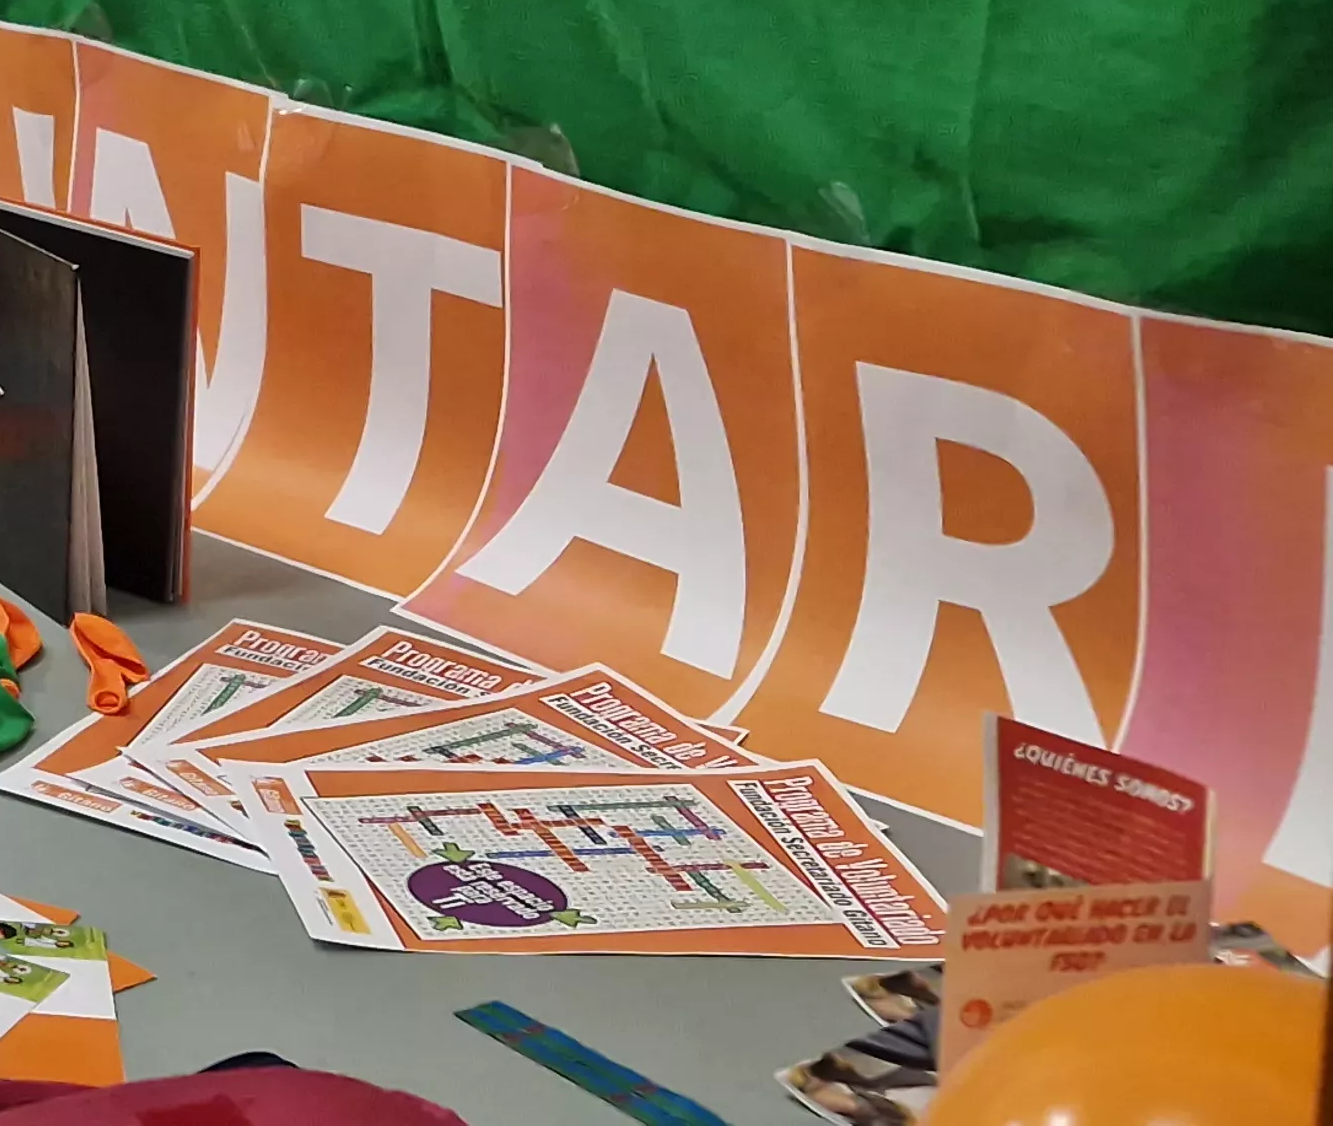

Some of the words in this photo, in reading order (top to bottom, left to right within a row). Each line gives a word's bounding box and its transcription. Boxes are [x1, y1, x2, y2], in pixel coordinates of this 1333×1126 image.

[368, 657, 470, 694] Fundación
[381, 640, 502, 689] Programa
[548, 695, 633, 745] Fundación
[570, 681, 677, 744] Programa
[663, 741, 707, 761] de
[763, 775, 845, 839] Programa
[735, 782, 791, 835] Fundación
[781, 836, 852, 906] Secretariado
[842, 909, 887, 945] Gitano
[817, 841, 869, 858] de
[835, 858, 946, 944] Voluntariado
